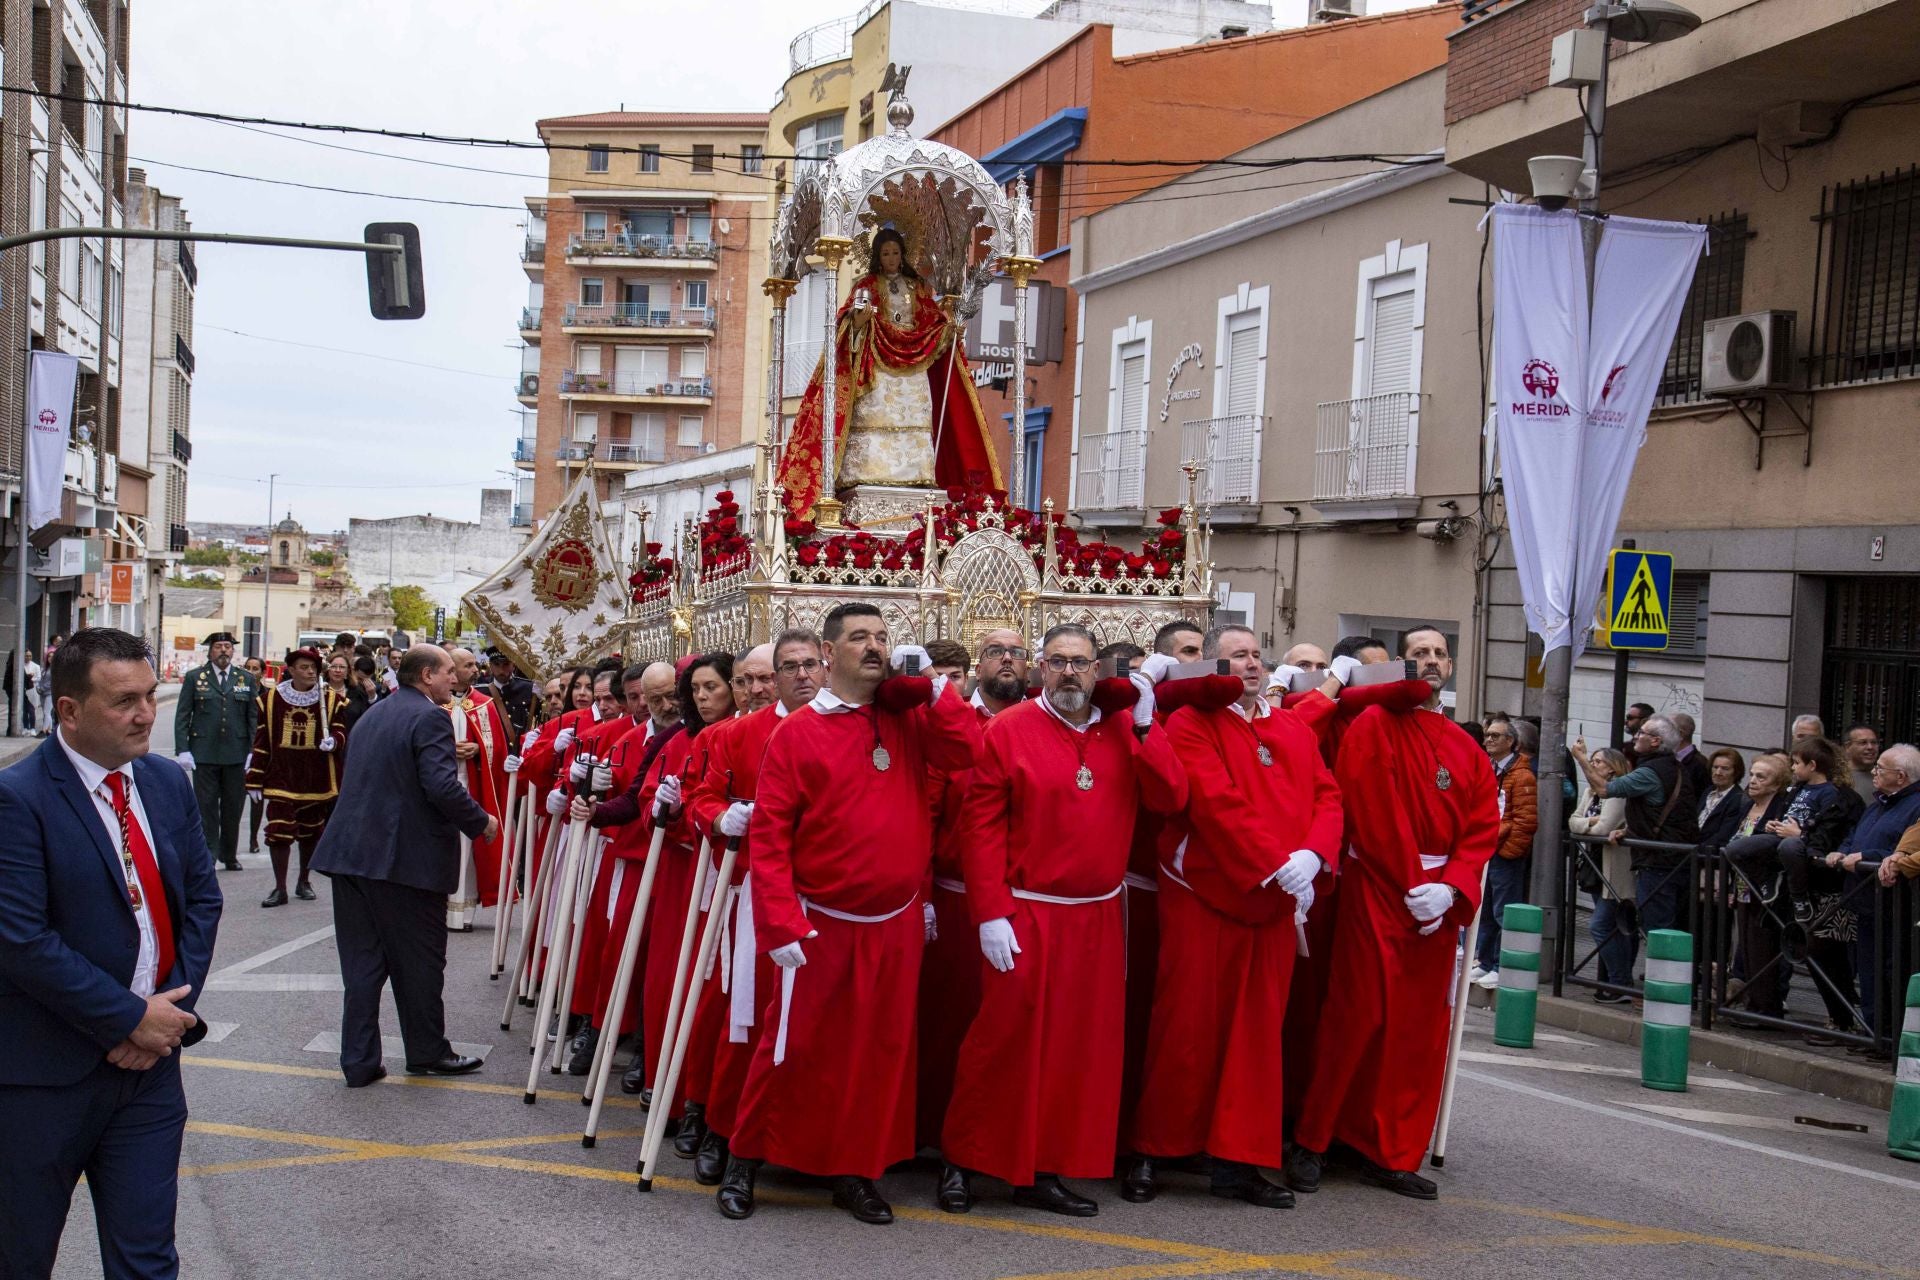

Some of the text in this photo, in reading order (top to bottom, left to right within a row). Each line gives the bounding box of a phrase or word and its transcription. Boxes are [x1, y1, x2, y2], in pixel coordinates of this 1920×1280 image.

[980, 283, 1039, 348] H
[980, 345, 1036, 360] HOSTL
[1512, 401, 1571, 416] MÉRIDA
[1875, 540, 1882, 557] 2
